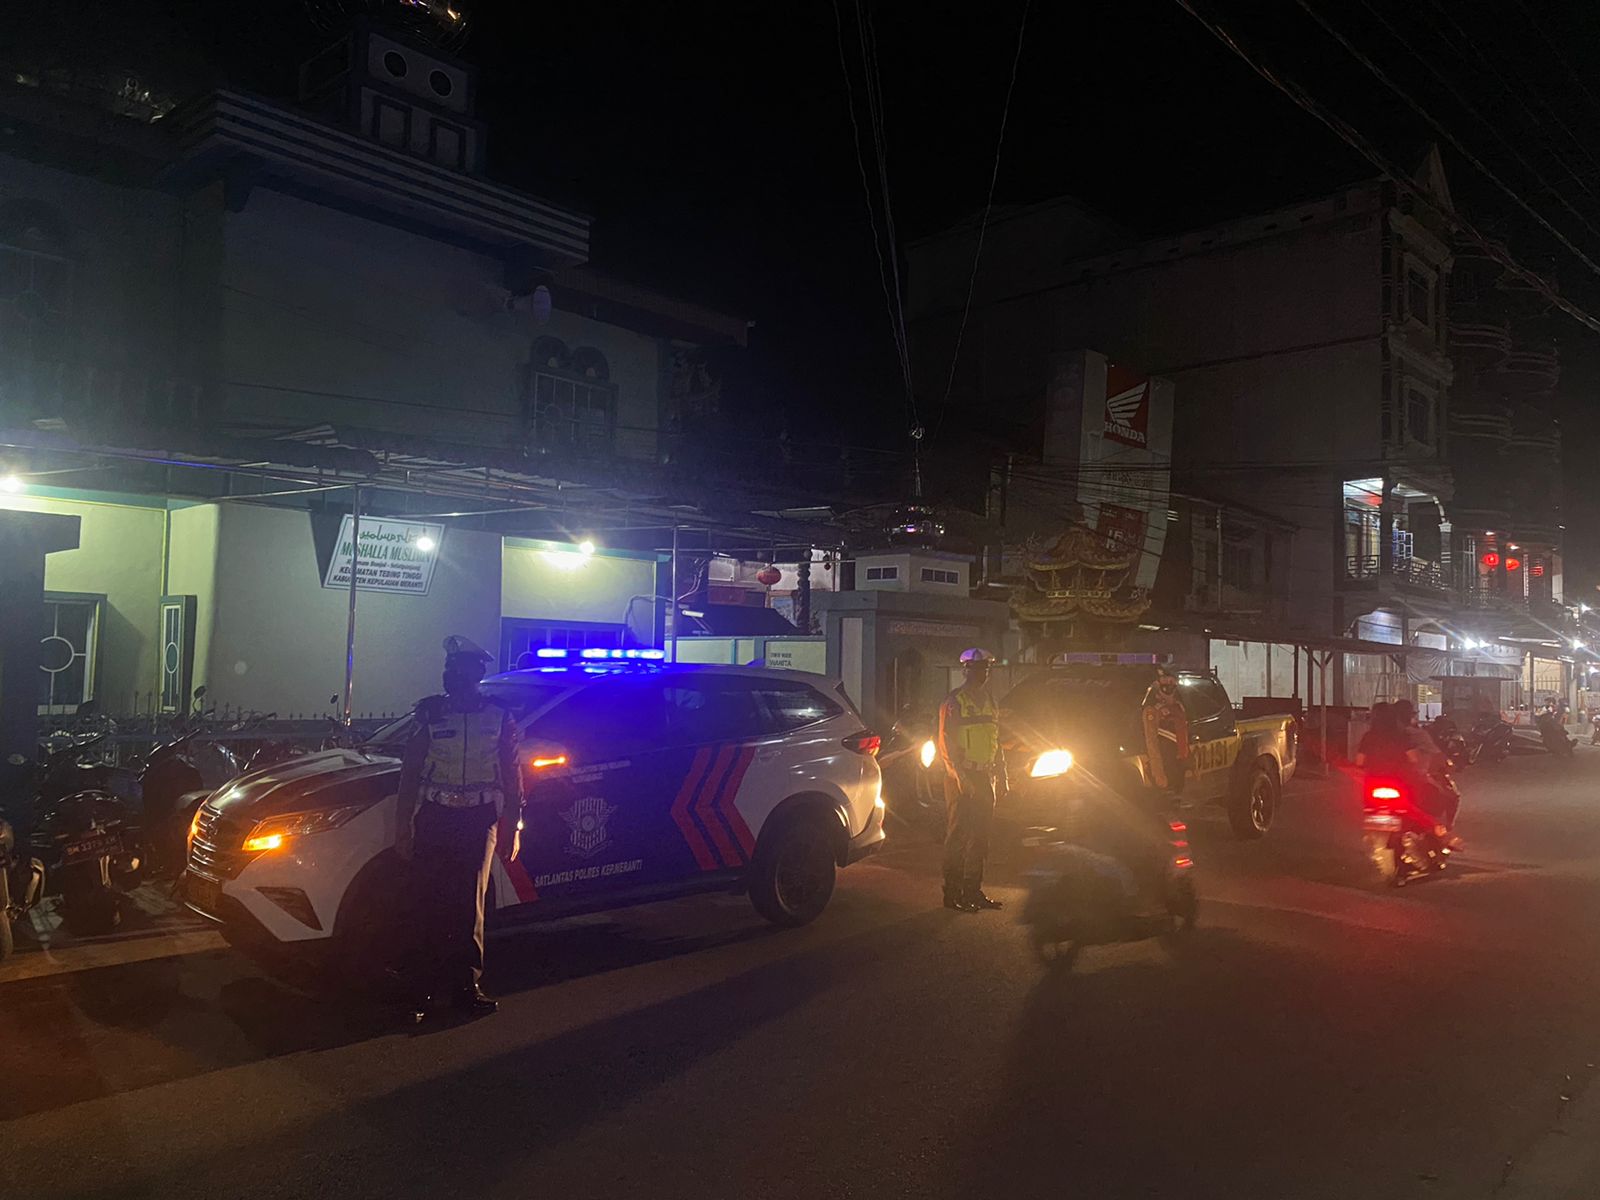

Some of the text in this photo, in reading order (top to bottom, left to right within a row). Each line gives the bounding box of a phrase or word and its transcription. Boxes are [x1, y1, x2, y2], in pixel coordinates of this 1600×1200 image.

[1104, 421, 1146, 444] HONDA
[339, 566, 423, 580] KECMATAN TEBING TINGGI
[534, 870, 574, 888] SATLANTAS
[574, 866, 601, 880] POLRES
